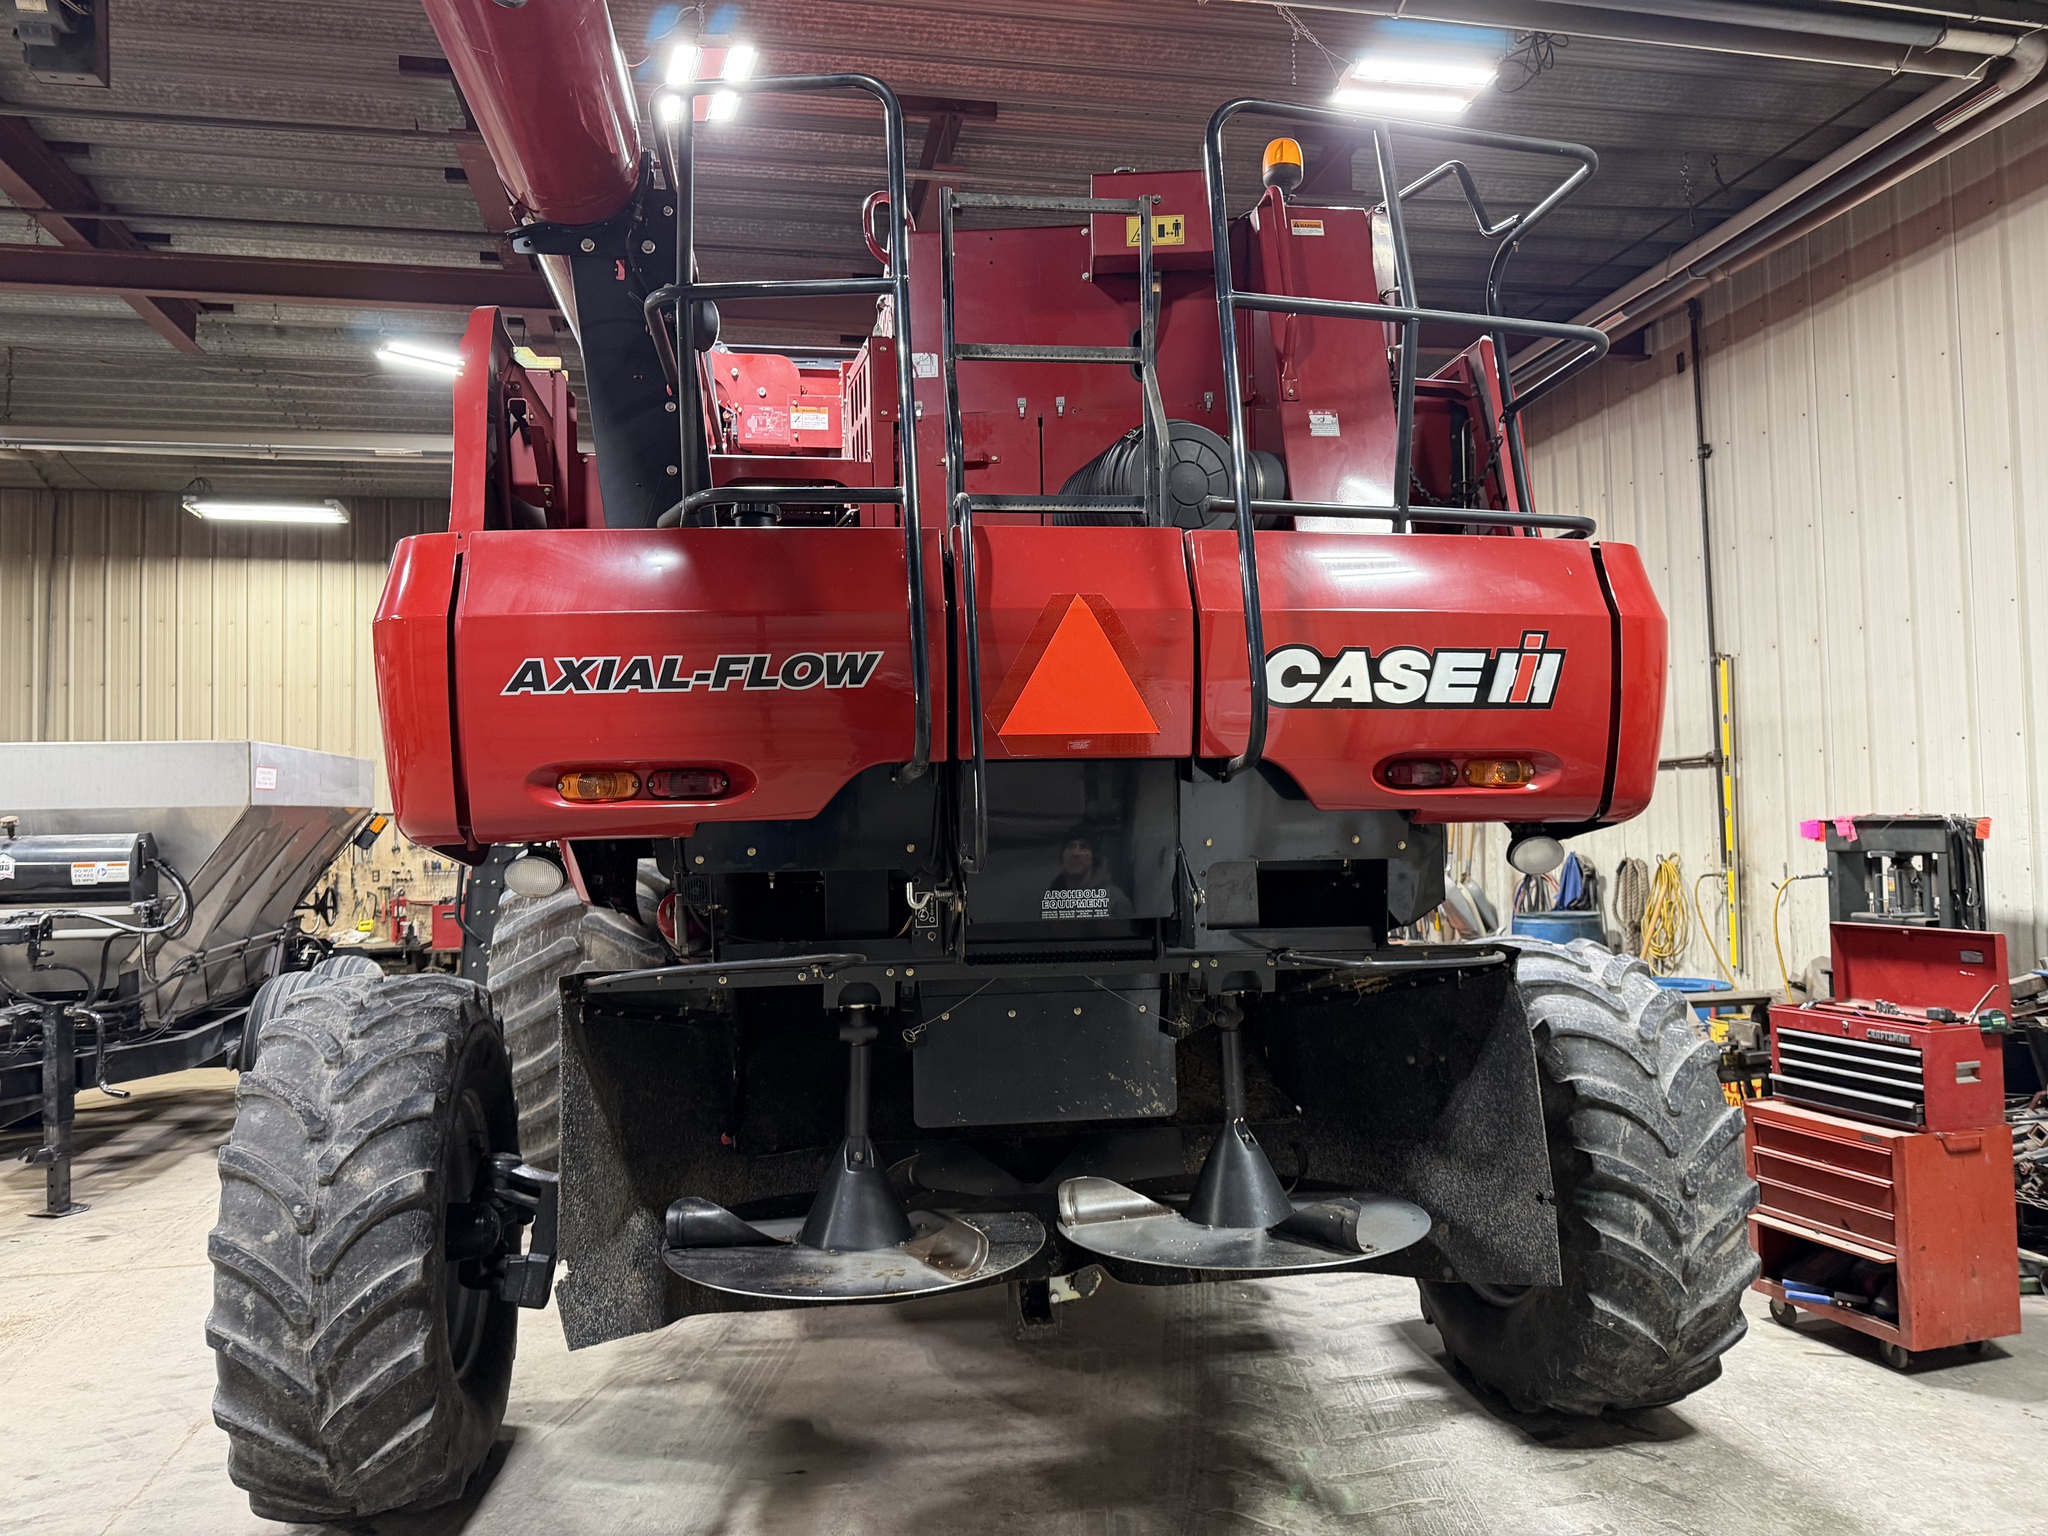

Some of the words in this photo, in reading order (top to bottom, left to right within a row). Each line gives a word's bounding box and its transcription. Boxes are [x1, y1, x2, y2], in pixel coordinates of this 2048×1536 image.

[500, 651, 884, 696] AXIAL-FLOW
[1266, 646, 1489, 705] CASE
[1044, 889, 1107, 899] ARCHBOLD
[1042, 898, 1109, 909] EQUIPMENT
[1866, 1028, 1911, 1044] CRAFTSMAN
